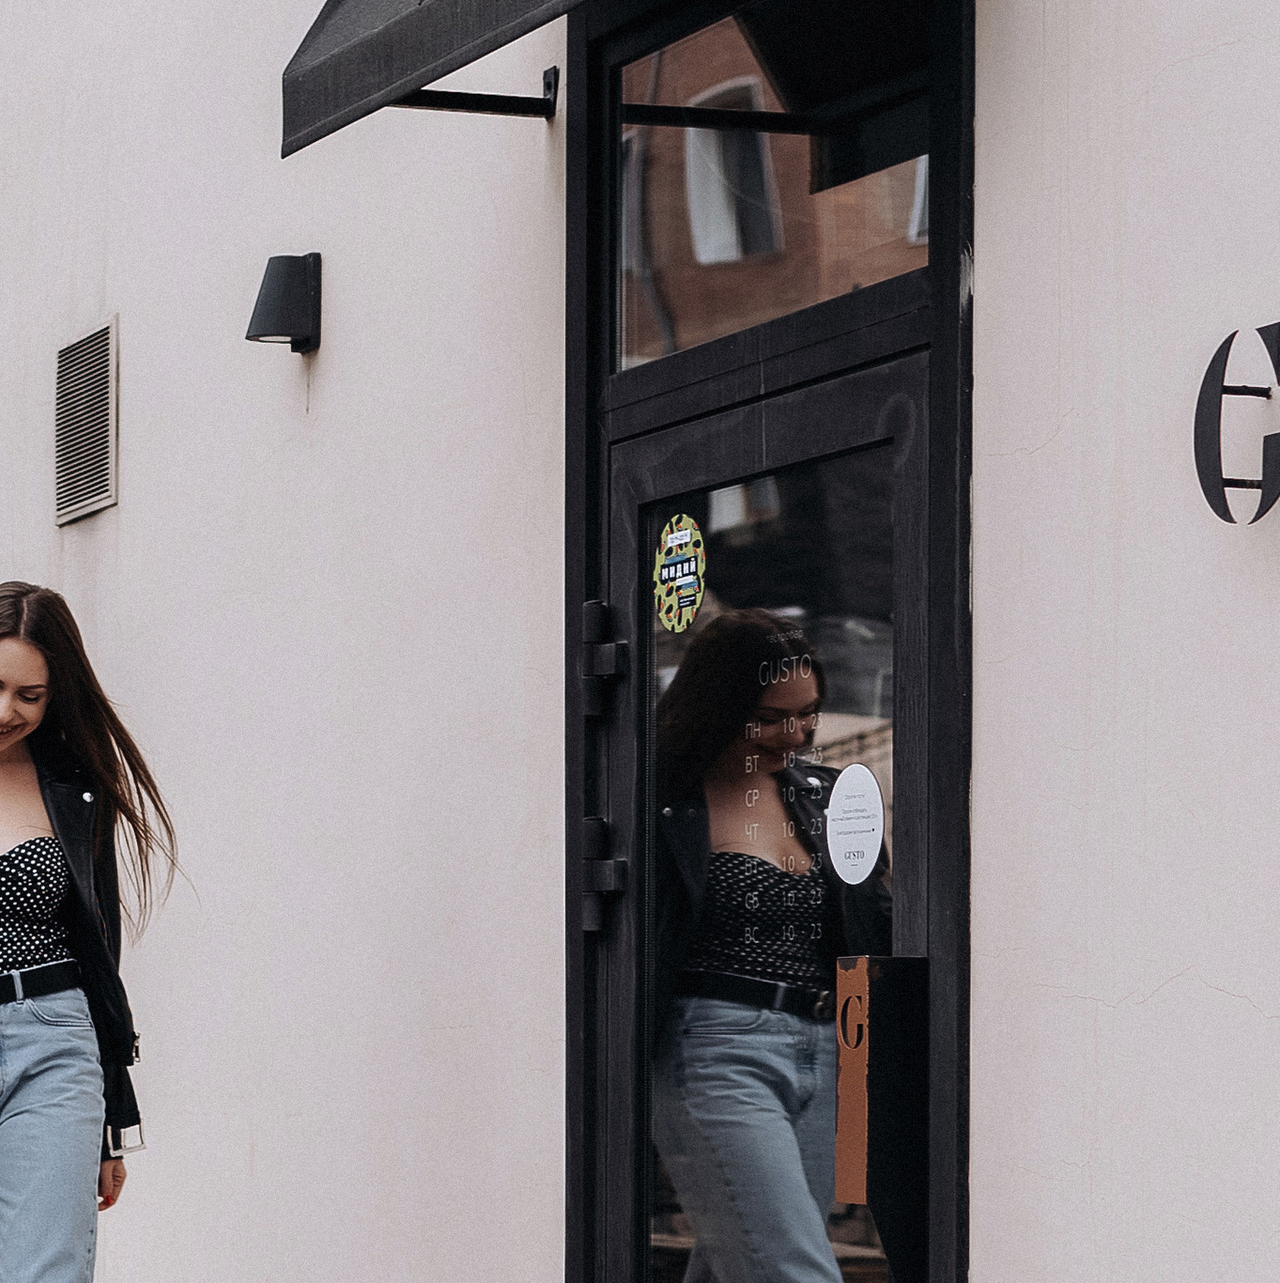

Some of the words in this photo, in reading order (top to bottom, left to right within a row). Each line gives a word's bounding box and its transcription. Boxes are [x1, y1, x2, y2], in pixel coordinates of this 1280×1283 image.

[661, 557, 696, 580] МИДИЙ
[758, 653, 812, 686] GUSTO
[745, 721, 761, 740] ПН
[783, 716, 796, 733] 10
[810, 712, 823, 730] 23
[745, 754, 760, 773] ВТ
[783, 751, 796, 768] 10
[810, 747, 823, 764] 23
[745, 789, 760, 808] СР
[783, 786, 796, 803] 10
[810, 783, 823, 799] 23
[745, 823, 759, 841] ЧТ
[782, 821, 795, 838] 10
[810, 818, 823, 835] 23
[782, 855, 795, 872] 10
[810, 852, 823, 871] 23
[844, 850, 865, 861] GUSTO
[744, 926, 760, 944] ВС
[782, 924, 795, 941] 10
[810, 923, 823, 939] 23
[840, 995, 864, 1050] G
